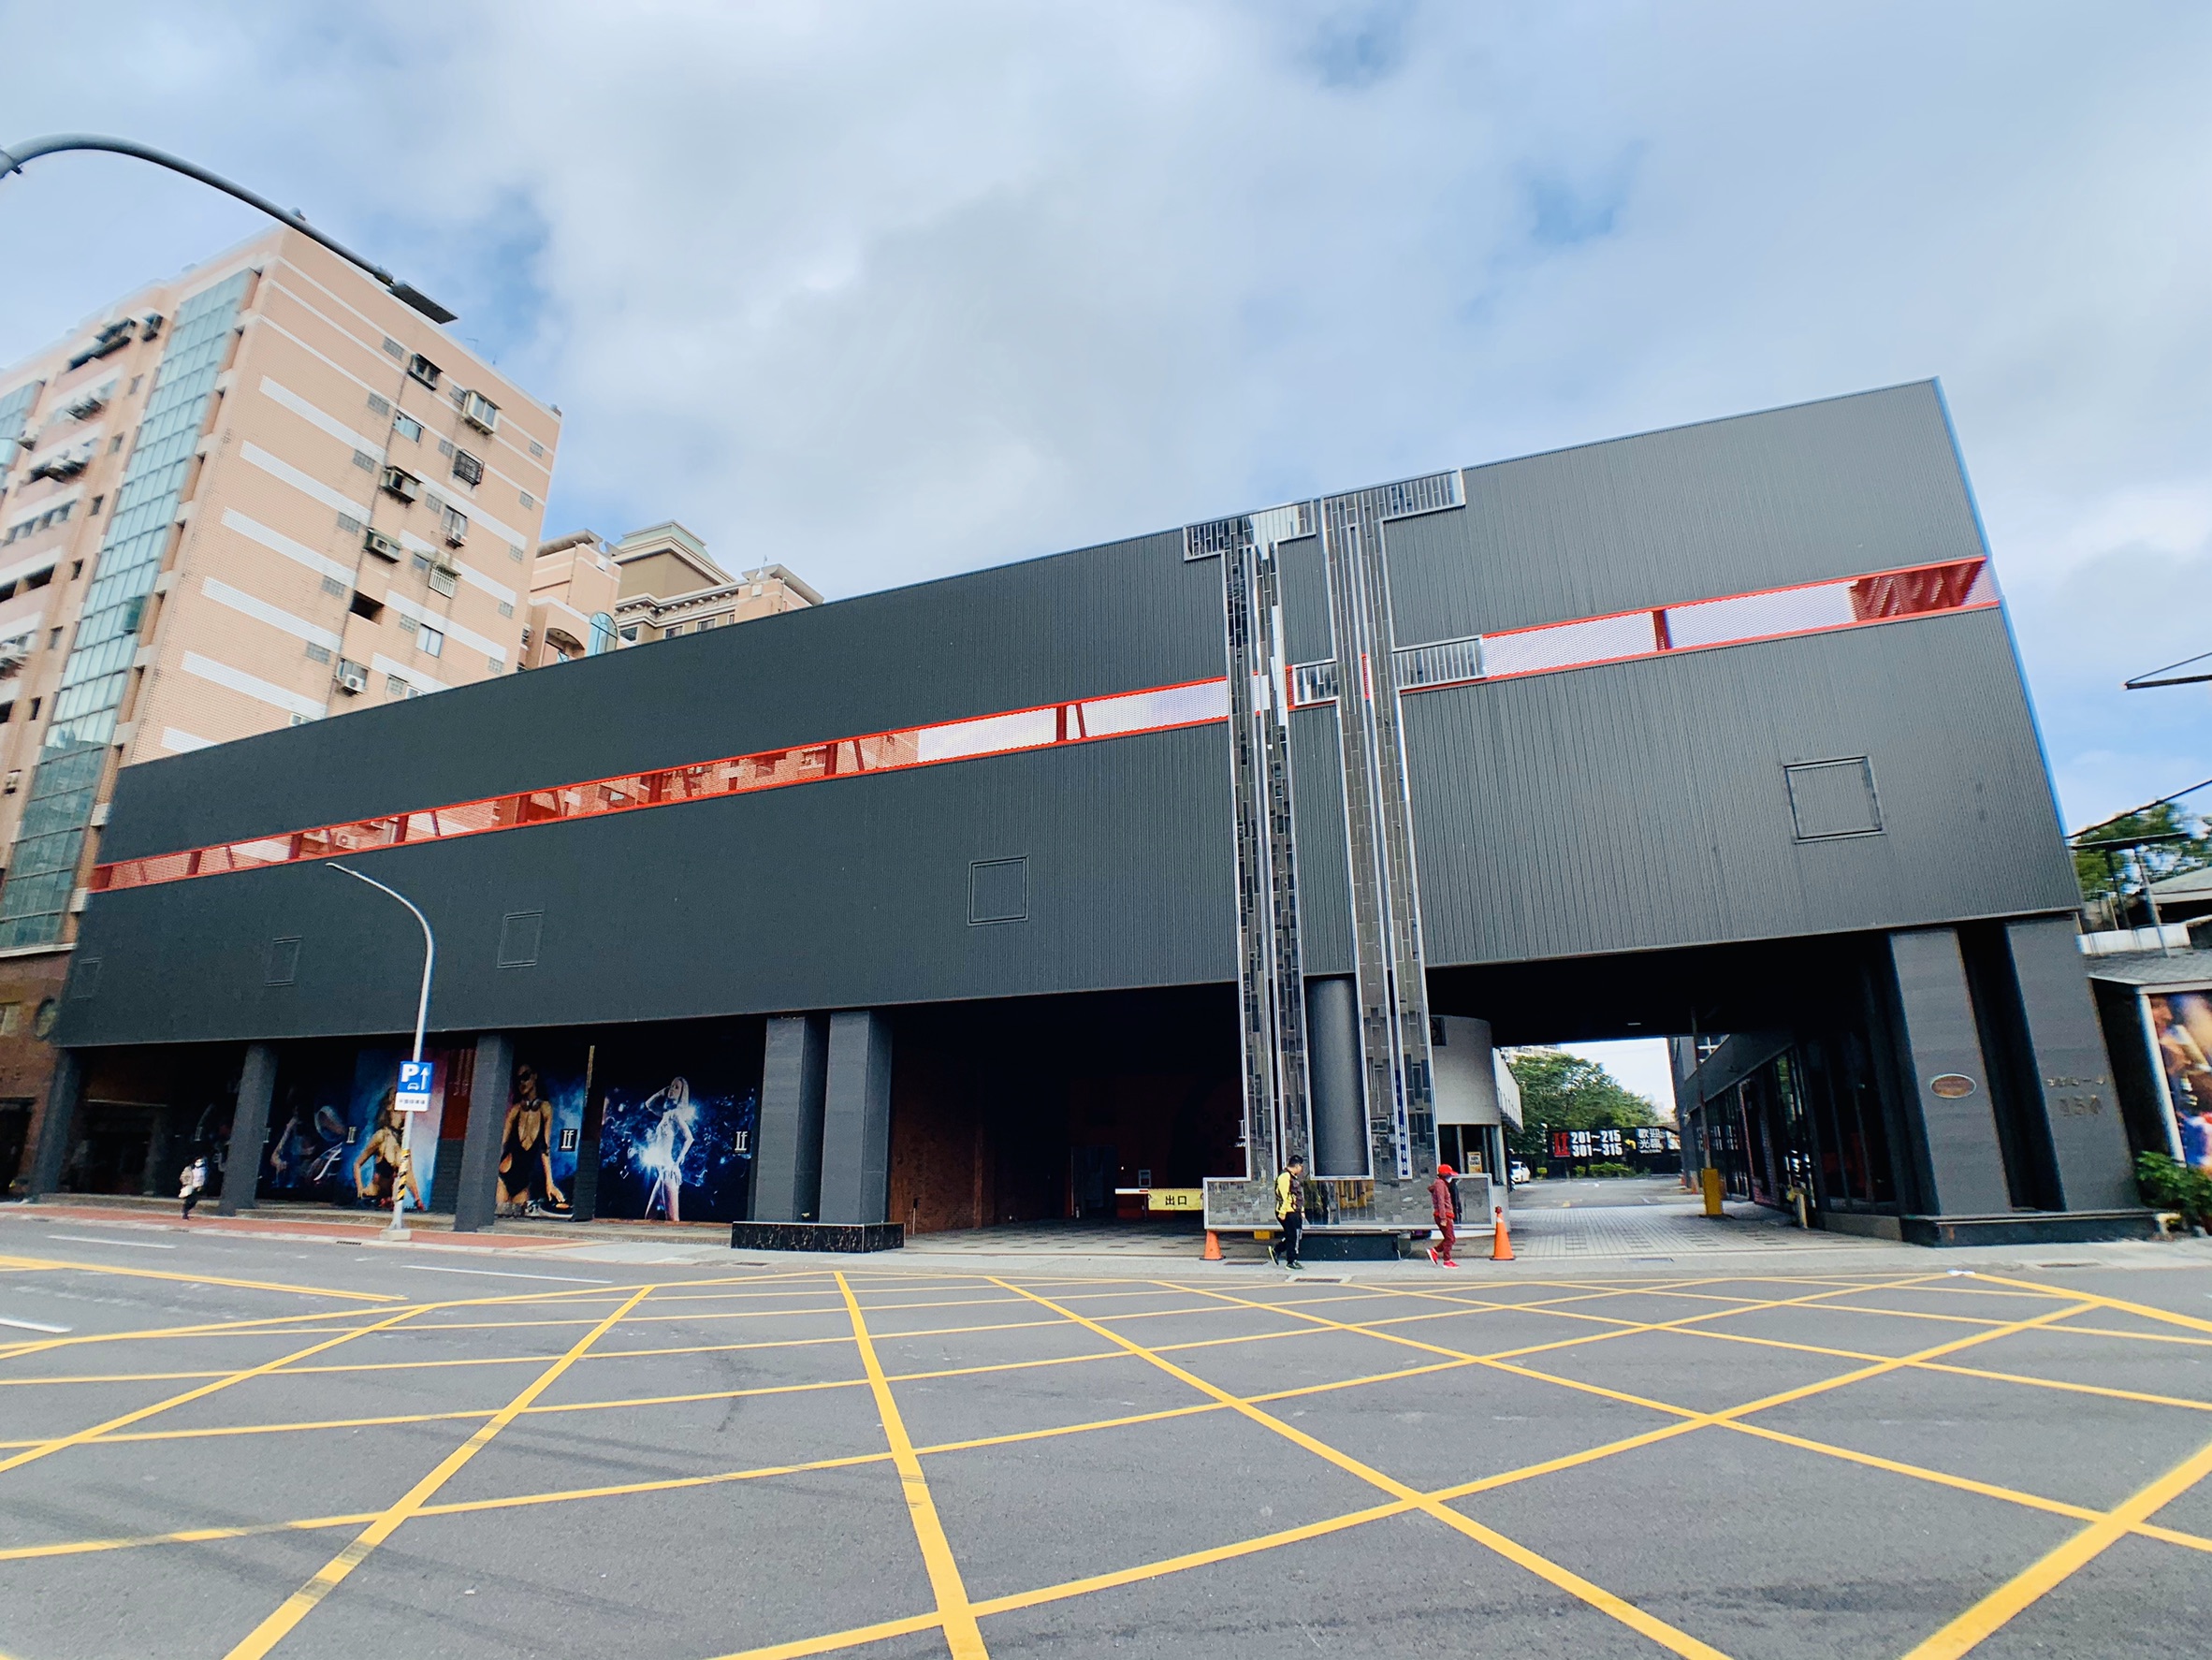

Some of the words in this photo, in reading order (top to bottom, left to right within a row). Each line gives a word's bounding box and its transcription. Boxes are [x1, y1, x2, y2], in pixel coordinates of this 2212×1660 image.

[400, 1063, 419, 1083] P
[560, 1129, 575, 1149] If
[735, 1130, 748, 1151] If
[1165, 1194, 1187, 1206] 出口
